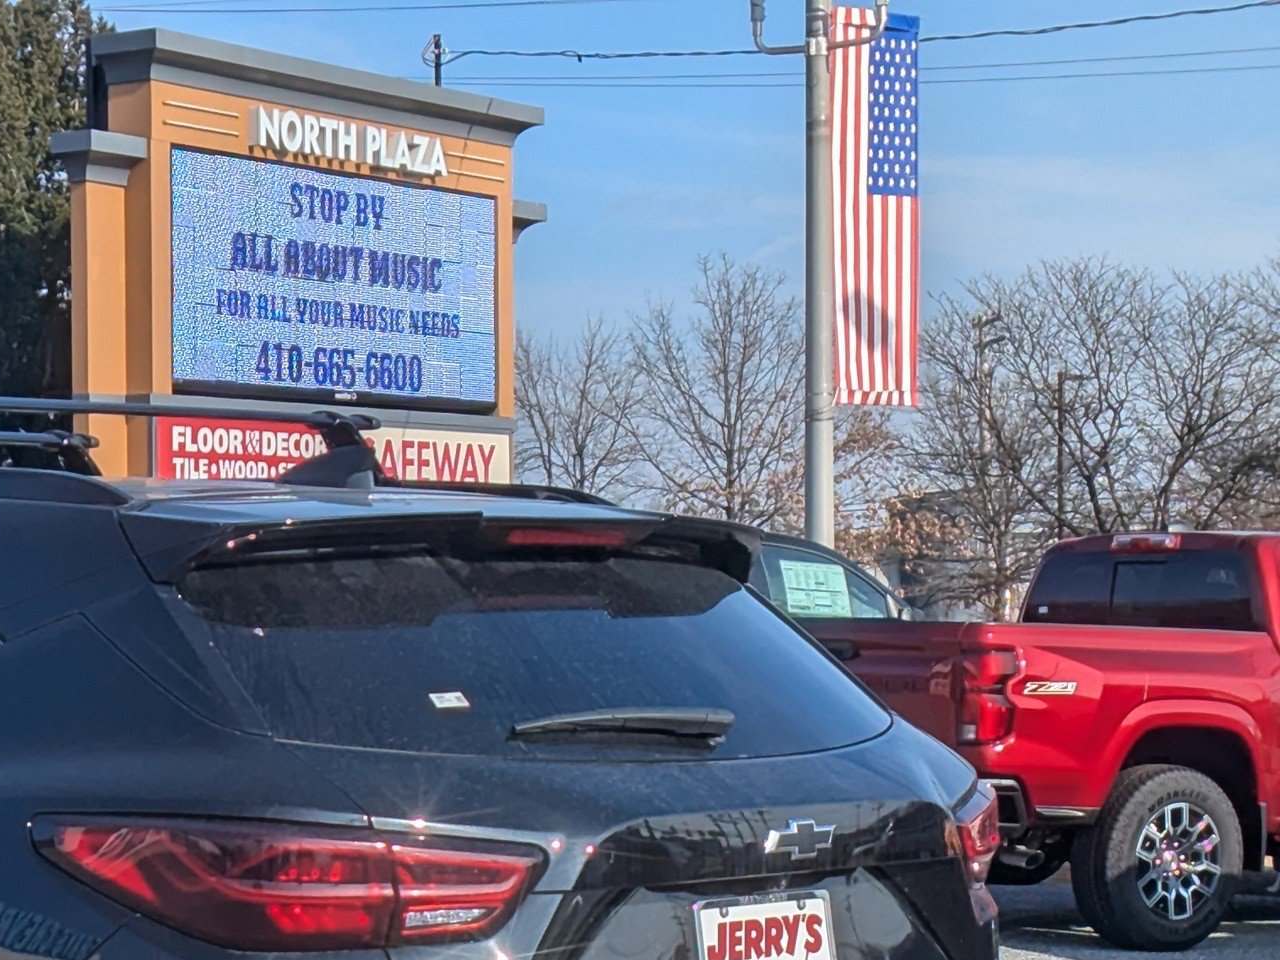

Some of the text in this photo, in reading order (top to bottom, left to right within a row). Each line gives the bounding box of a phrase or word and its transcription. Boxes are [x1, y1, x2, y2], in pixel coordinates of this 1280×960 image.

[257, 105, 449, 176] NORTH PLAZA
[289, 182, 385, 230] STOP BY
[231, 231, 443, 294] ALL ABOUT MUSIC
[216, 288, 461, 339] FOR ALL YOUR MUSIC NEEDS
[255, 340, 422, 392] 410-665-6600
[172, 425, 245, 455] FLOOR
[366, 437, 497, 485] AFEWAY
[172, 457, 209, 480] TILE
[218, 461, 266, 480] WOOD
